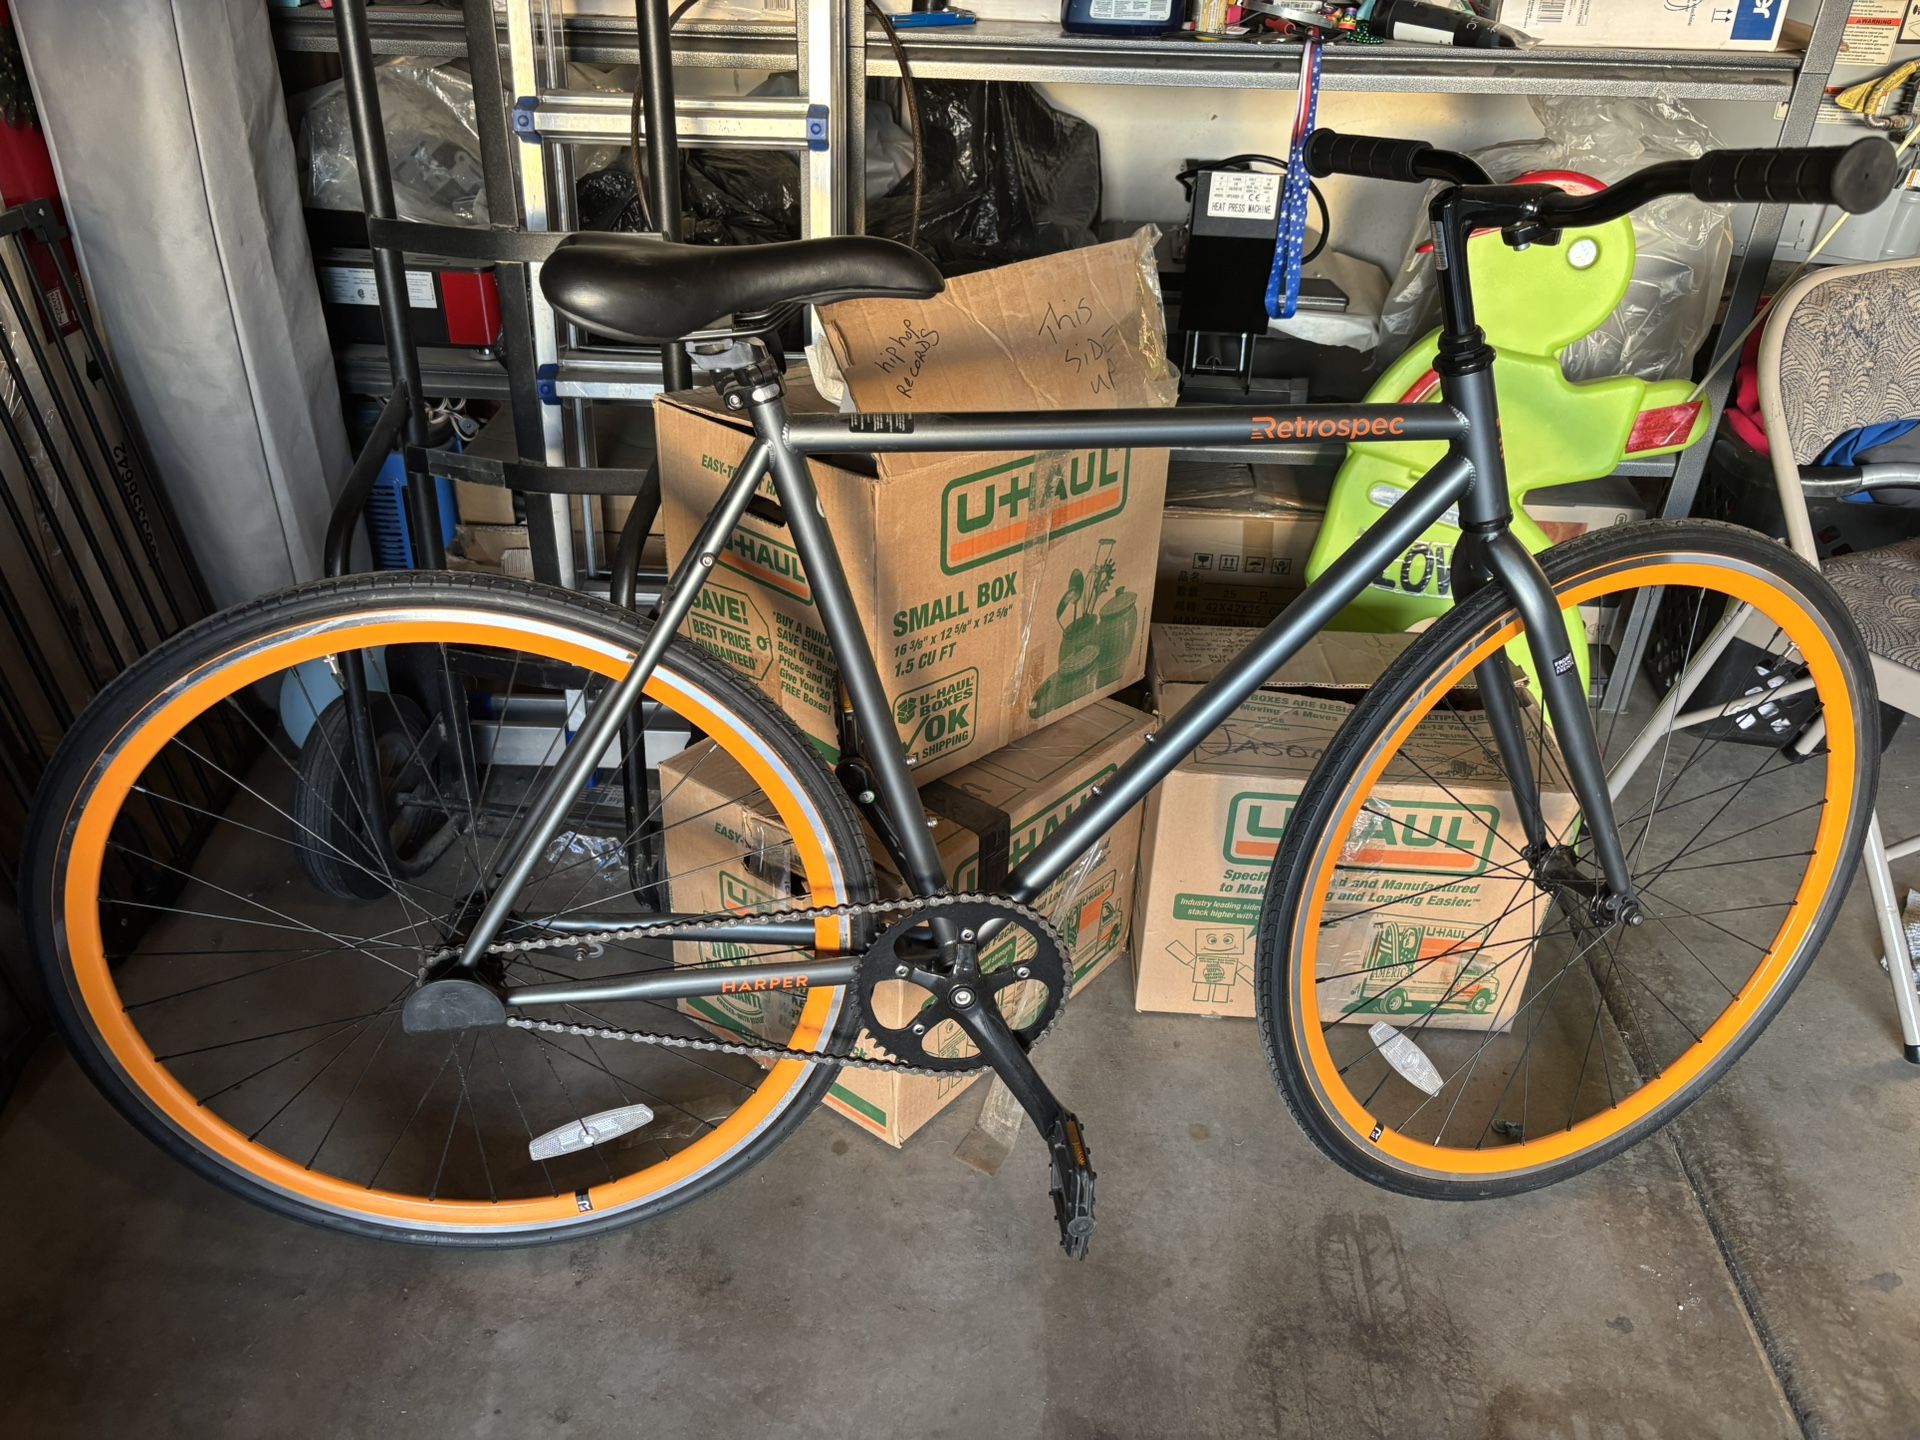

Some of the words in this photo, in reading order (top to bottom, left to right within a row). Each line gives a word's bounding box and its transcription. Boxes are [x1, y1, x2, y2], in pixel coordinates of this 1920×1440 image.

[1212, 202, 1226, 211] HEAT
[1228, 203, 1245, 213] PRESS
[1248, 204, 1271, 214] MACHINE
[1251, 416, 1405, 440] Retrospec
[893, 591, 969, 637] SMALL
[977, 571, 1018, 608] BOX
[692, 618, 718, 640] BEST
[720, 628, 752, 653] PRICE
[777, 627, 799, 646] SAVE
[802, 640, 826, 659] EVEN
[796, 622, 802, 634] A
[805, 625, 831, 647] BUND
[895, 644, 907, 658] 16
[941, 627, 952, 640] 12
[984, 611, 995, 624] 12
[778, 641, 796, 658] Beat
[799, 651, 814, 666] Our
[816, 660, 838, 677] Bund
[779, 654, 804, 674] Prices
[806, 670, 823, 684] and
[895, 658, 914, 677] 1.5
[918, 650, 936, 669] CU
[940, 642, 957, 661] FT
[780, 668, 797, 684] Give
[800, 677, 815, 693] You
[920, 678, 974, 705] U-HAUL
[781, 680, 801, 699] FREE
[803, 693, 832, 715] Boxes!
[920, 688, 973, 717] BOXES
[1251, 694, 1289, 704] BOXES
[1293, 699, 1316, 708] ARE
[925, 703, 969, 742] OK
[1240, 703, 1280, 715] Moving
[1303, 711, 1338, 722] Moves
[922, 731, 968, 758] SHIPPING
[1224, 869, 1270, 882] Specif
[1352, 879, 1379, 889] and
[1181, 898, 1212, 908] Industry
[1214, 901, 1241, 910] leading
[1220, 883, 1233, 892] to
[1237, 884, 1265, 894] Mak
[1338, 892, 1363, 901] and
[1368, 892, 1424, 906] Loading
[1210, 910, 1235, 918] higher
[1426, 927, 1467, 939] U-HAUL
[722, 975, 809, 993] HARPER
